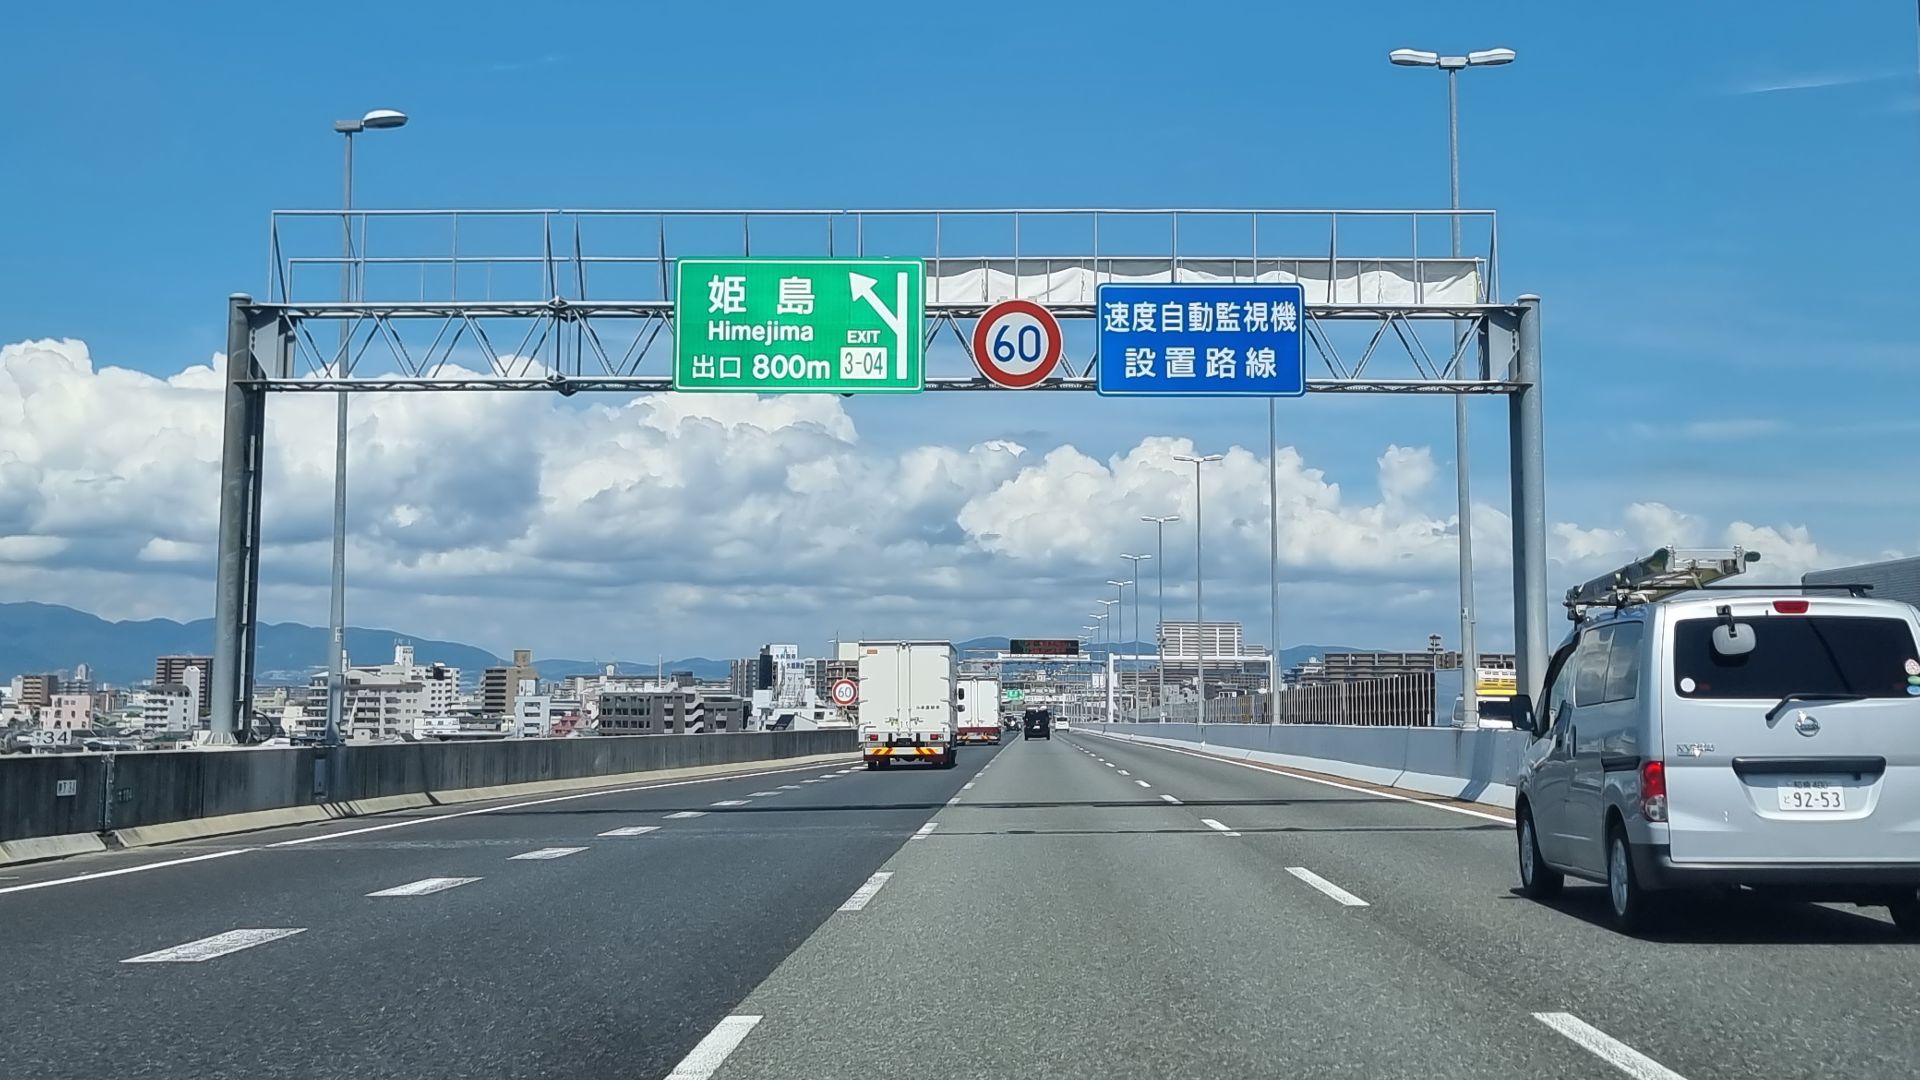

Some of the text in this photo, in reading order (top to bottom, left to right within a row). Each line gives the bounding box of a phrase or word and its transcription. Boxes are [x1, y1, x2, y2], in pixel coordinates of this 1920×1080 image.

[708, 275, 815, 315] 姫島
[1104, 302, 1297, 333] 速度自動監視機
[708, 320, 814, 346] Himejima
[847, 330, 880, 344] EXIT
[993, 325, 1041, 362] 60
[692, 354, 831, 379] 出口 800m
[844, 352, 883, 375] 3-04
[1125, 348, 1278, 379] 設置路線
[838, 686, 852, 697] 60
[43, 731, 68, 744] 34
[1794, 792, 1841, 807] 92-53
